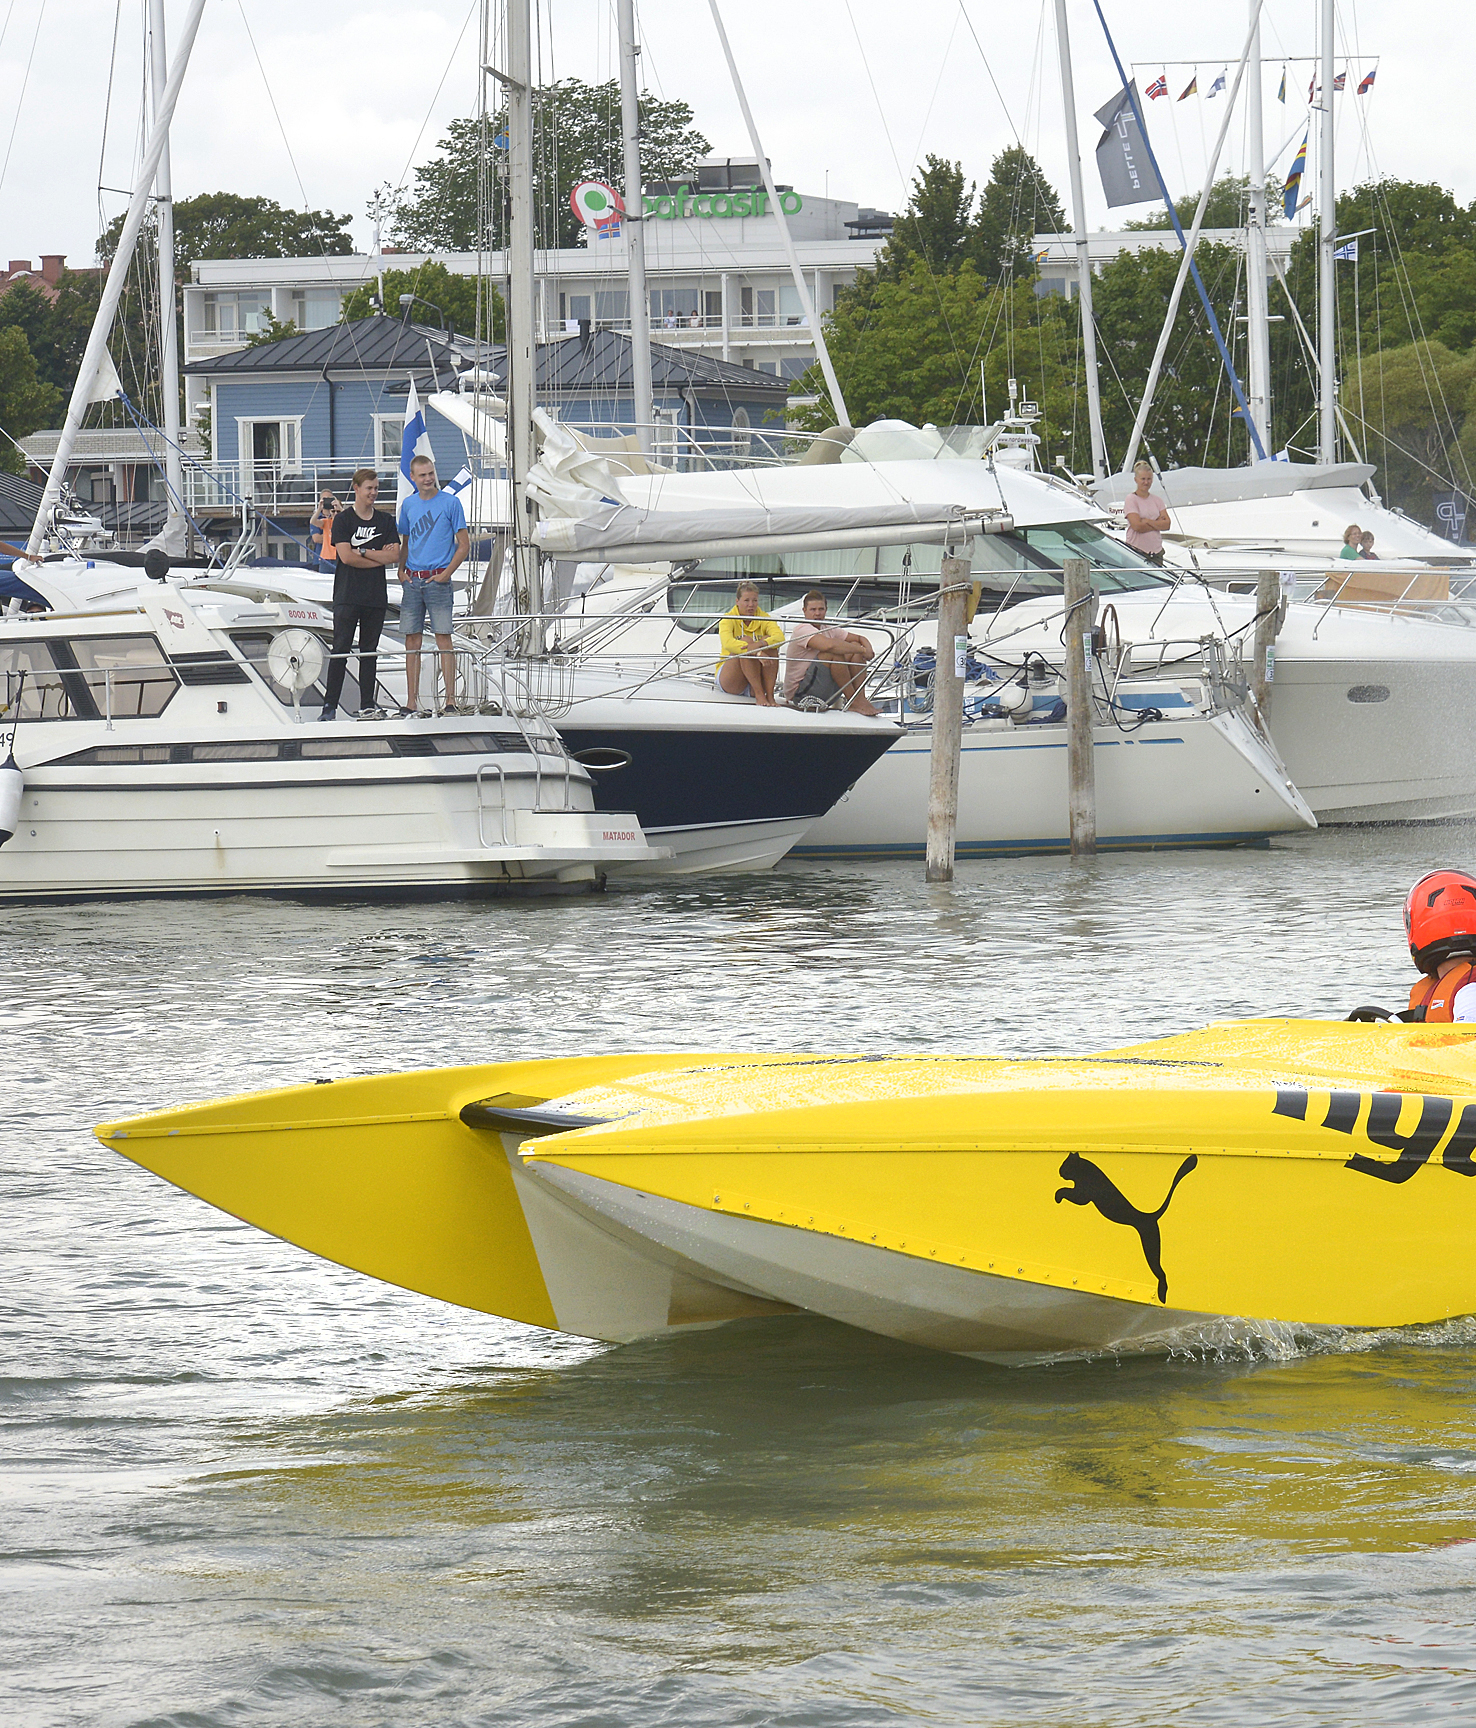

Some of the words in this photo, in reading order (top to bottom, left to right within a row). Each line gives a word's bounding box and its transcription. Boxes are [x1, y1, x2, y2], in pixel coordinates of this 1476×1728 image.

[692, 184, 803, 218] casino
[410, 510, 435, 544] RUN
[288, 609, 306, 619] 8000
[307, 611, 318, 620] XR
[602, 831, 636, 841] MATADOR
